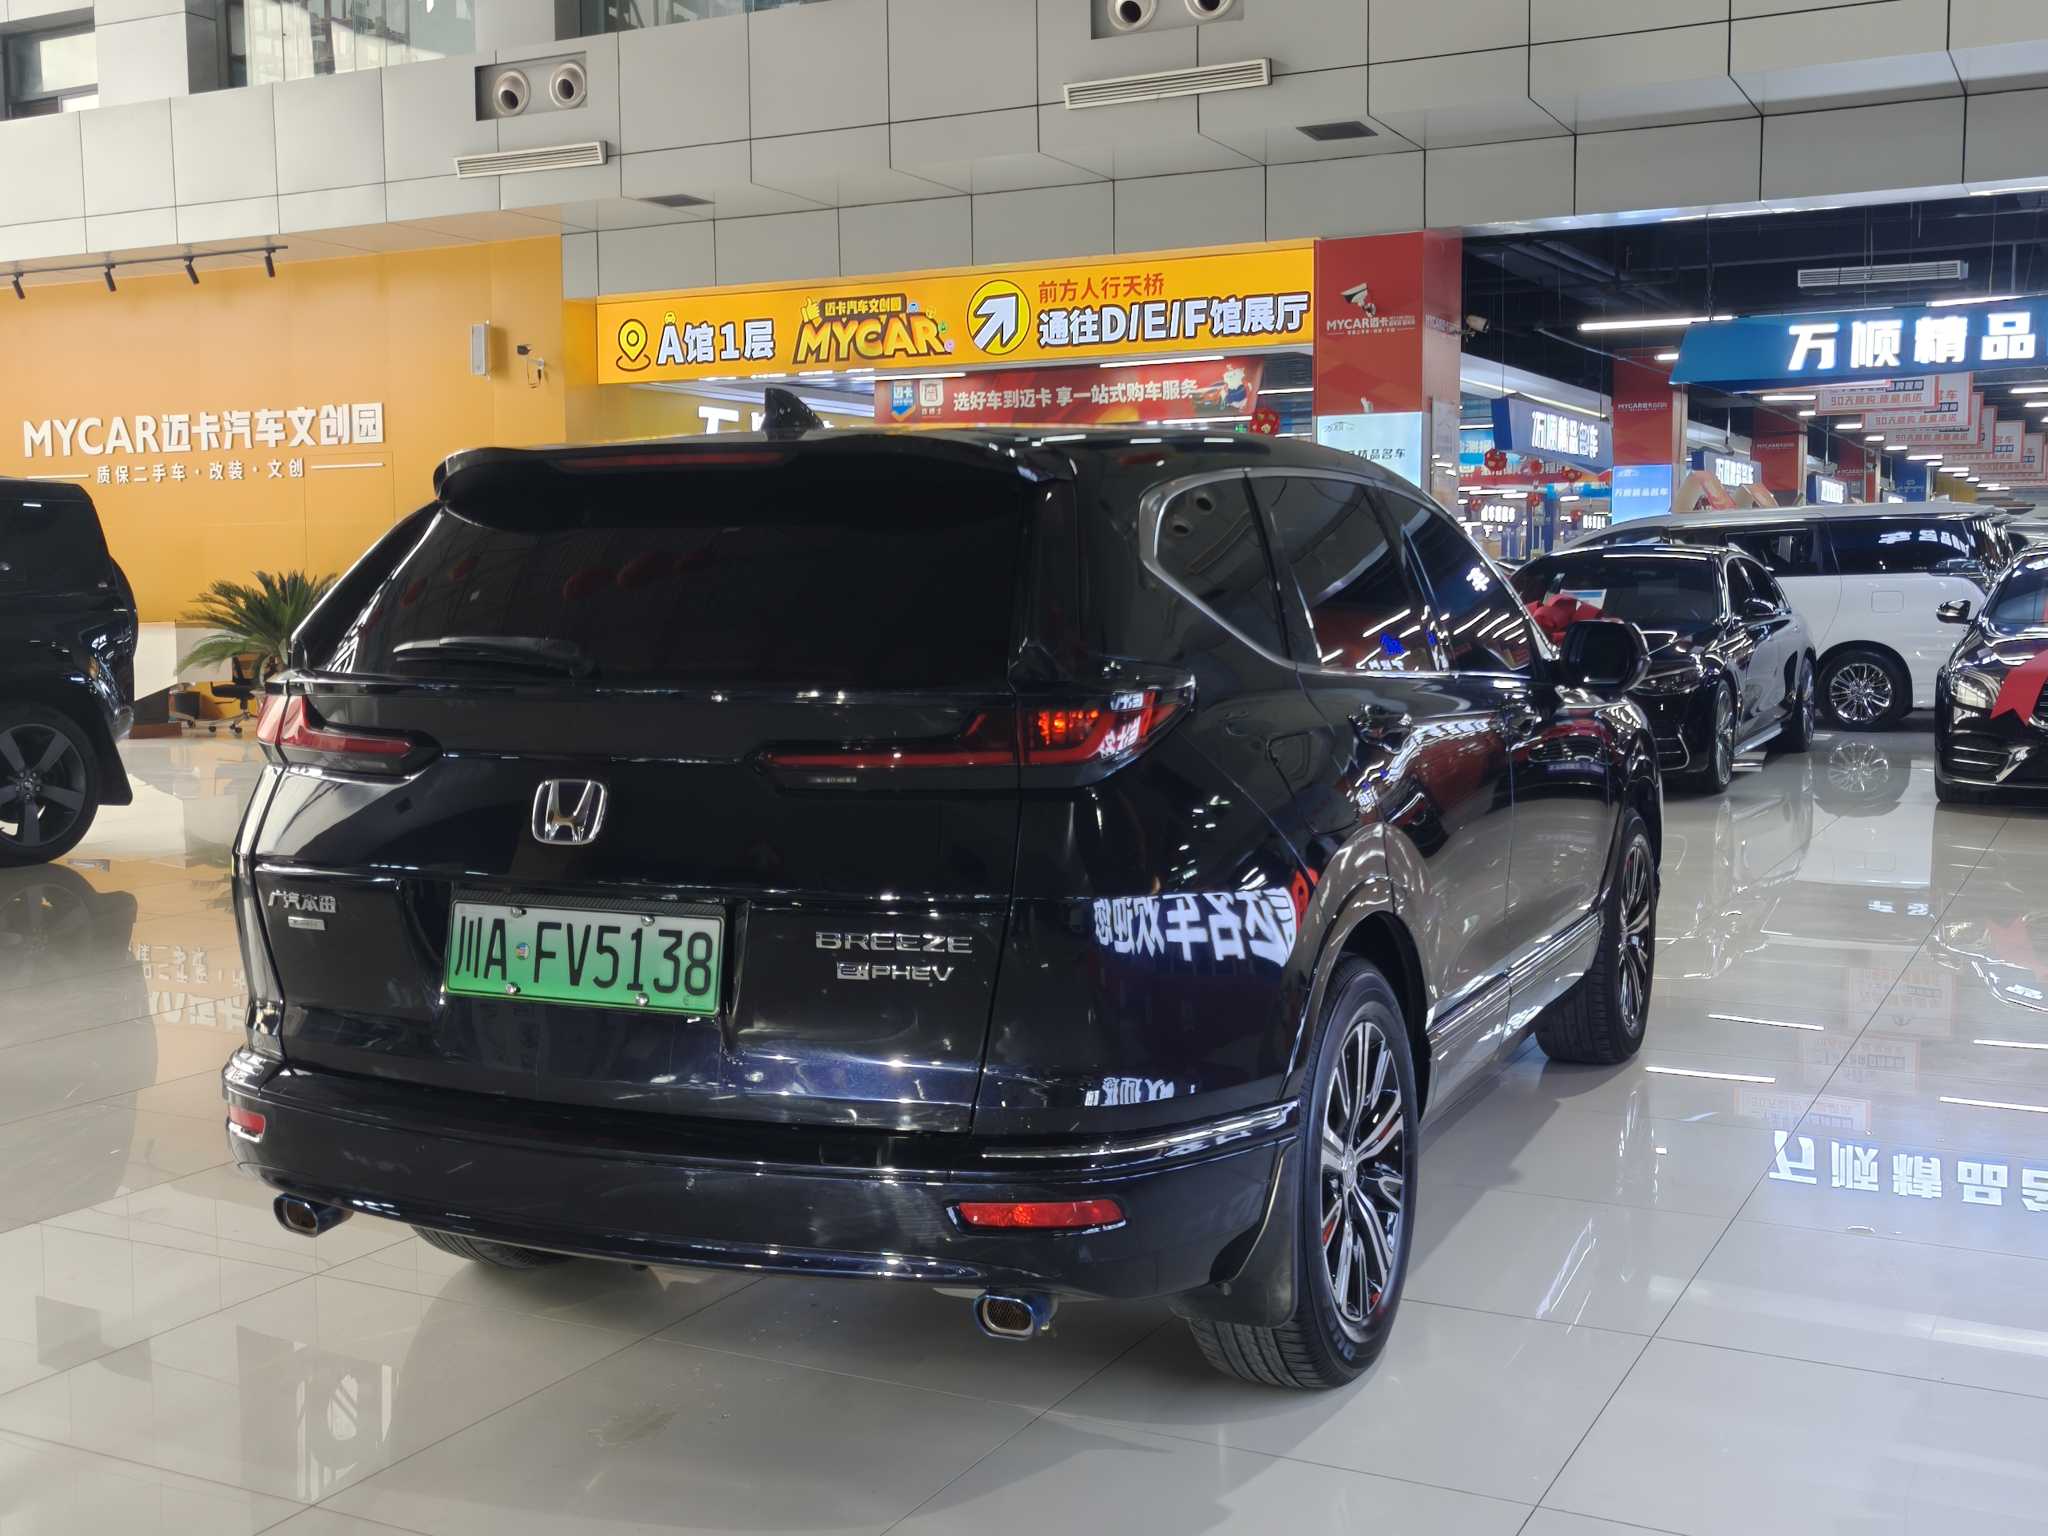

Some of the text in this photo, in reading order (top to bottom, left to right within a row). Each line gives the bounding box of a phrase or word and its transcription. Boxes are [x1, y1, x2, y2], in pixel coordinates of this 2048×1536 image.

[1038, 273, 1165, 303] 前方人行天桥
[795, 314, 946, 363] MYCAR
[1038, 293, 1309, 347] 通往D/E/F馆展厅
[1787, 310, 2036, 371] 万顺精品
[953, 387, 1052, 412] 选好车到迈卡
[23, 402, 384, 458] MYCAR迈卡汽车文创园
[815, 931, 973, 954] BREEZE
